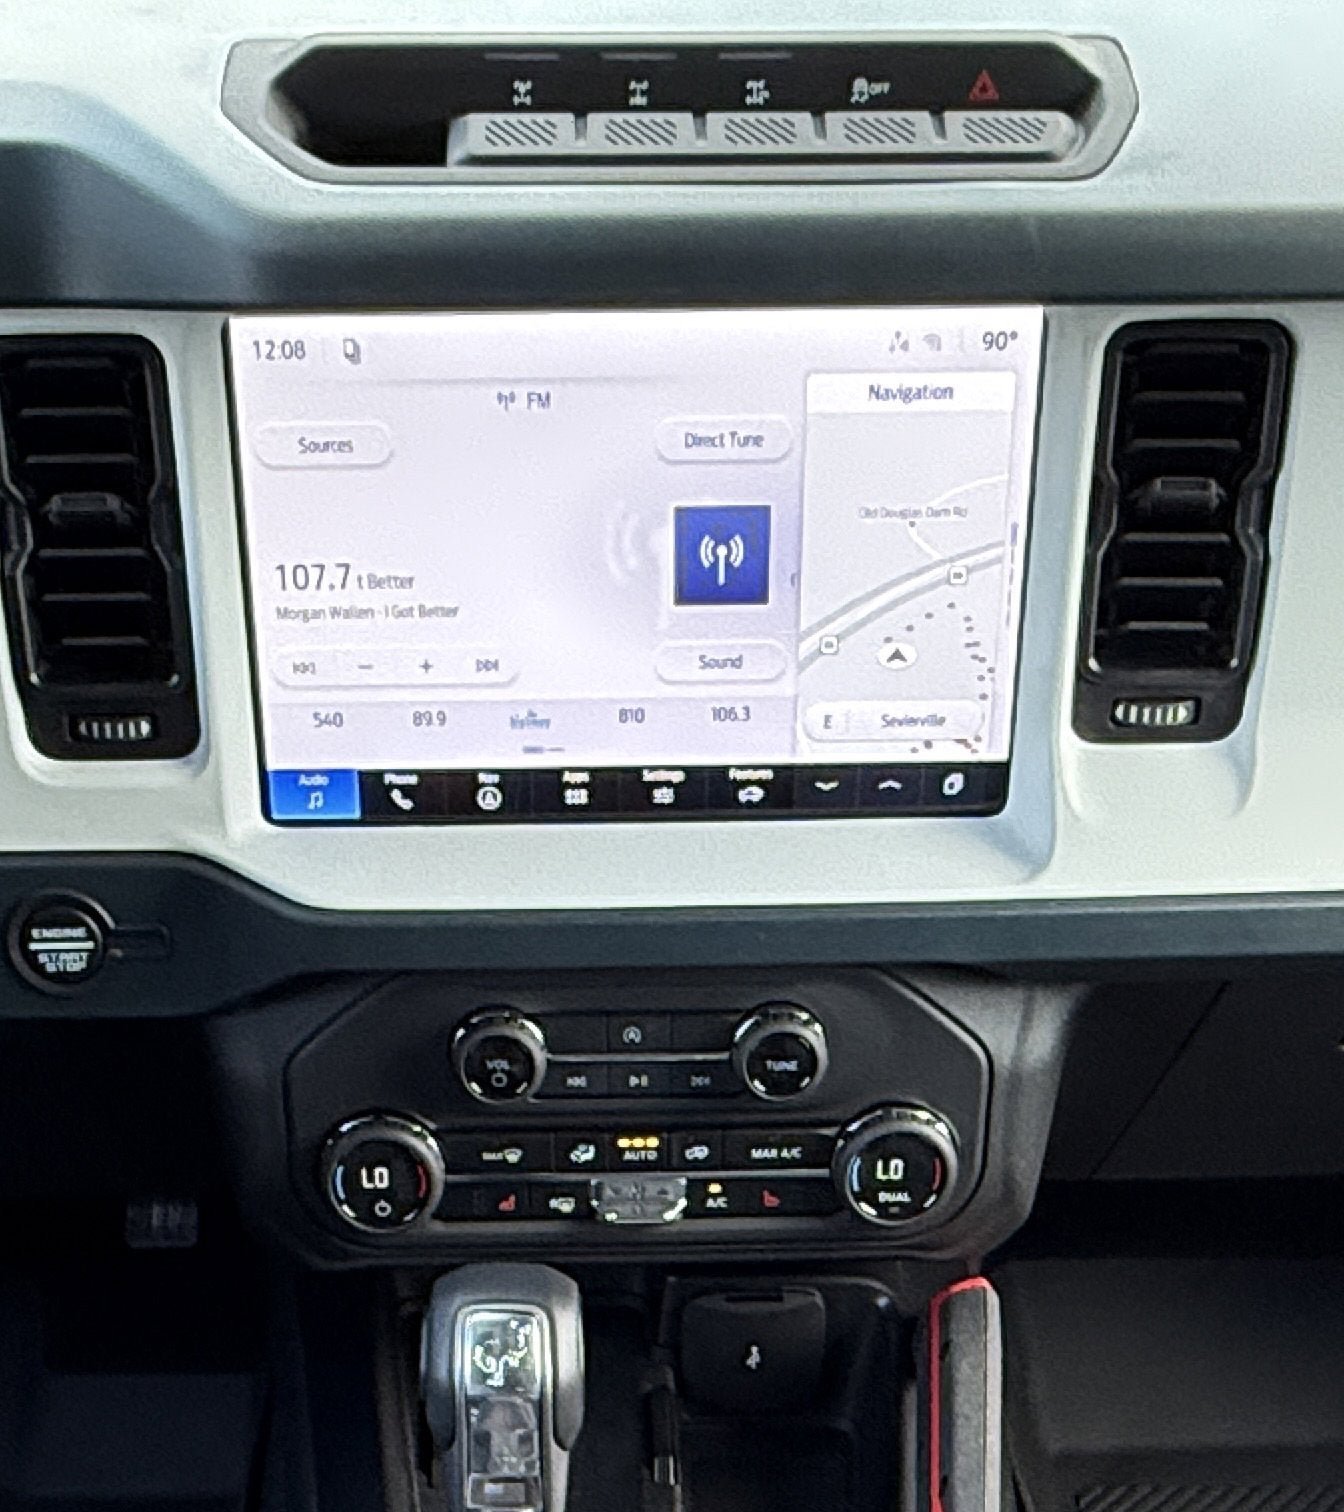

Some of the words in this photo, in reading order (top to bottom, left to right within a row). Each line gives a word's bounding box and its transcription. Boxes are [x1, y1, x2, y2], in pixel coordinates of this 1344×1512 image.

[982, 329, 1018, 352] 90°
[252, 339, 307, 361] 12:08
[526, 391, 551, 410] FM
[868, 384, 954, 404] Navigation
[297, 436, 354, 455] Sources
[684, 430, 725, 449] Direct
[729, 430, 765, 449] Tune
[859, 506, 878, 519] Old
[880, 506, 922, 519] Douglas
[275, 563, 351, 591] 107.7
[367, 572, 415, 590] Better
[275, 606, 326, 623] Morgan
[329, 605, 375, 620] Wallen
[392, 604, 415, 619] Got
[418, 603, 460, 619] Better
[698, 654, 743, 670] Sound
[313, 712, 344, 728] 540
[412, 710, 446, 728] 89.9
[618, 707, 645, 724] 810
[711, 705, 751, 723] 106.3
[880, 713, 946, 729] Sevierville
[298, 774, 330, 787] Audio
[484, 1059, 512, 1072] VOL
[765, 1059, 799, 1073] TUNE
[623, 1150, 658, 1163] AUTO
